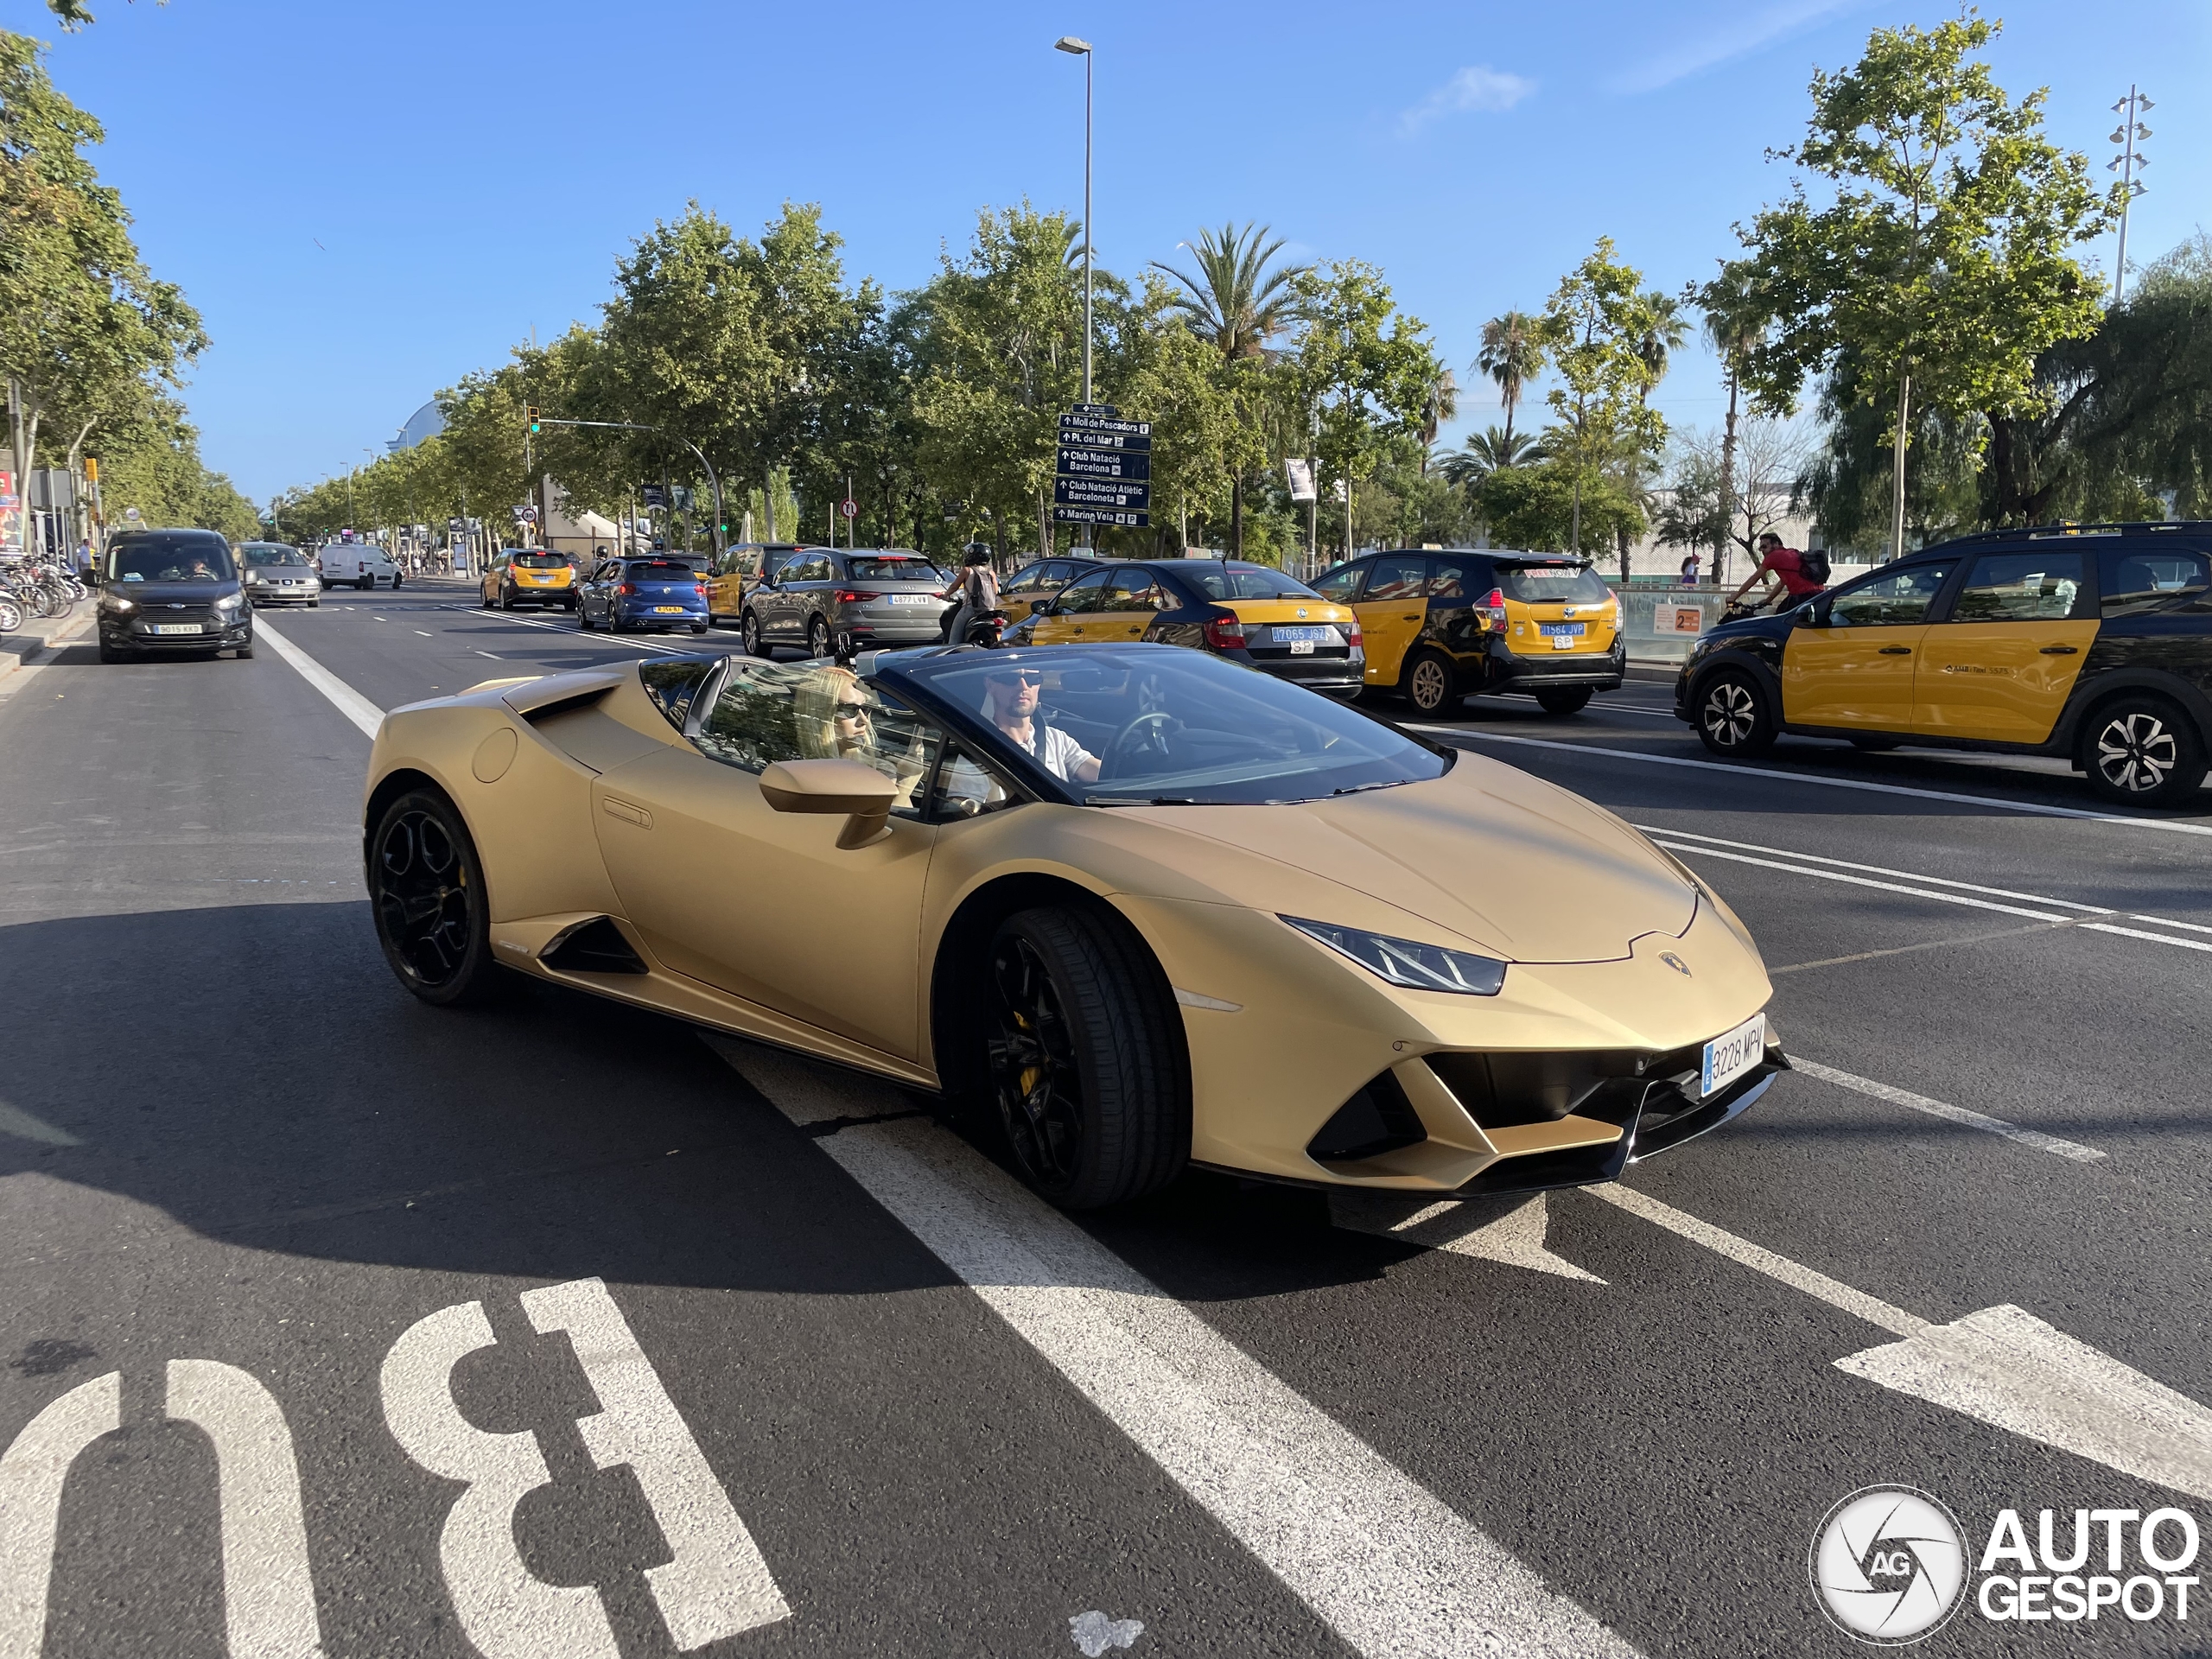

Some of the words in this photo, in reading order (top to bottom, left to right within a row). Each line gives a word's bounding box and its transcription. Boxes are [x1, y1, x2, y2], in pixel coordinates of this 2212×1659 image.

[1072, 416, 1088, 427] Moll
[1089, 419, 1098, 428] de
[1099, 420, 1138, 432] Pescadors
[1071, 433, 1082, 442] Pl.
[1084, 435, 1096, 443] del
[1097, 435, 1112, 445] Mar
[1071, 451, 1089, 461] Club
[1090, 453, 1121, 464] Natació
[1070, 461, 1109, 474] Barcelona
[1069, 480, 1086, 491] Club
[1088, 482, 1117, 493] Natació
[1118, 485, 1143, 495] Atlètic
[1068, 491, 1115, 502] Barceloneta
[1096, 512, 1114, 521] Vela
[1677, 615, 1685, 628] 2
[1279, 628, 1305, 639] 7065
[1308, 629, 1325, 639] JSZ
[1546, 625, 1566, 634] 1564
[1568, 625, 1583, 634] JVP
[1294, 641, 1311, 652] SP
[1556, 637, 1571, 646] SP
[1713, 1039, 1742, 1080] 3228
[1744, 1024, 1763, 1064] MPV
